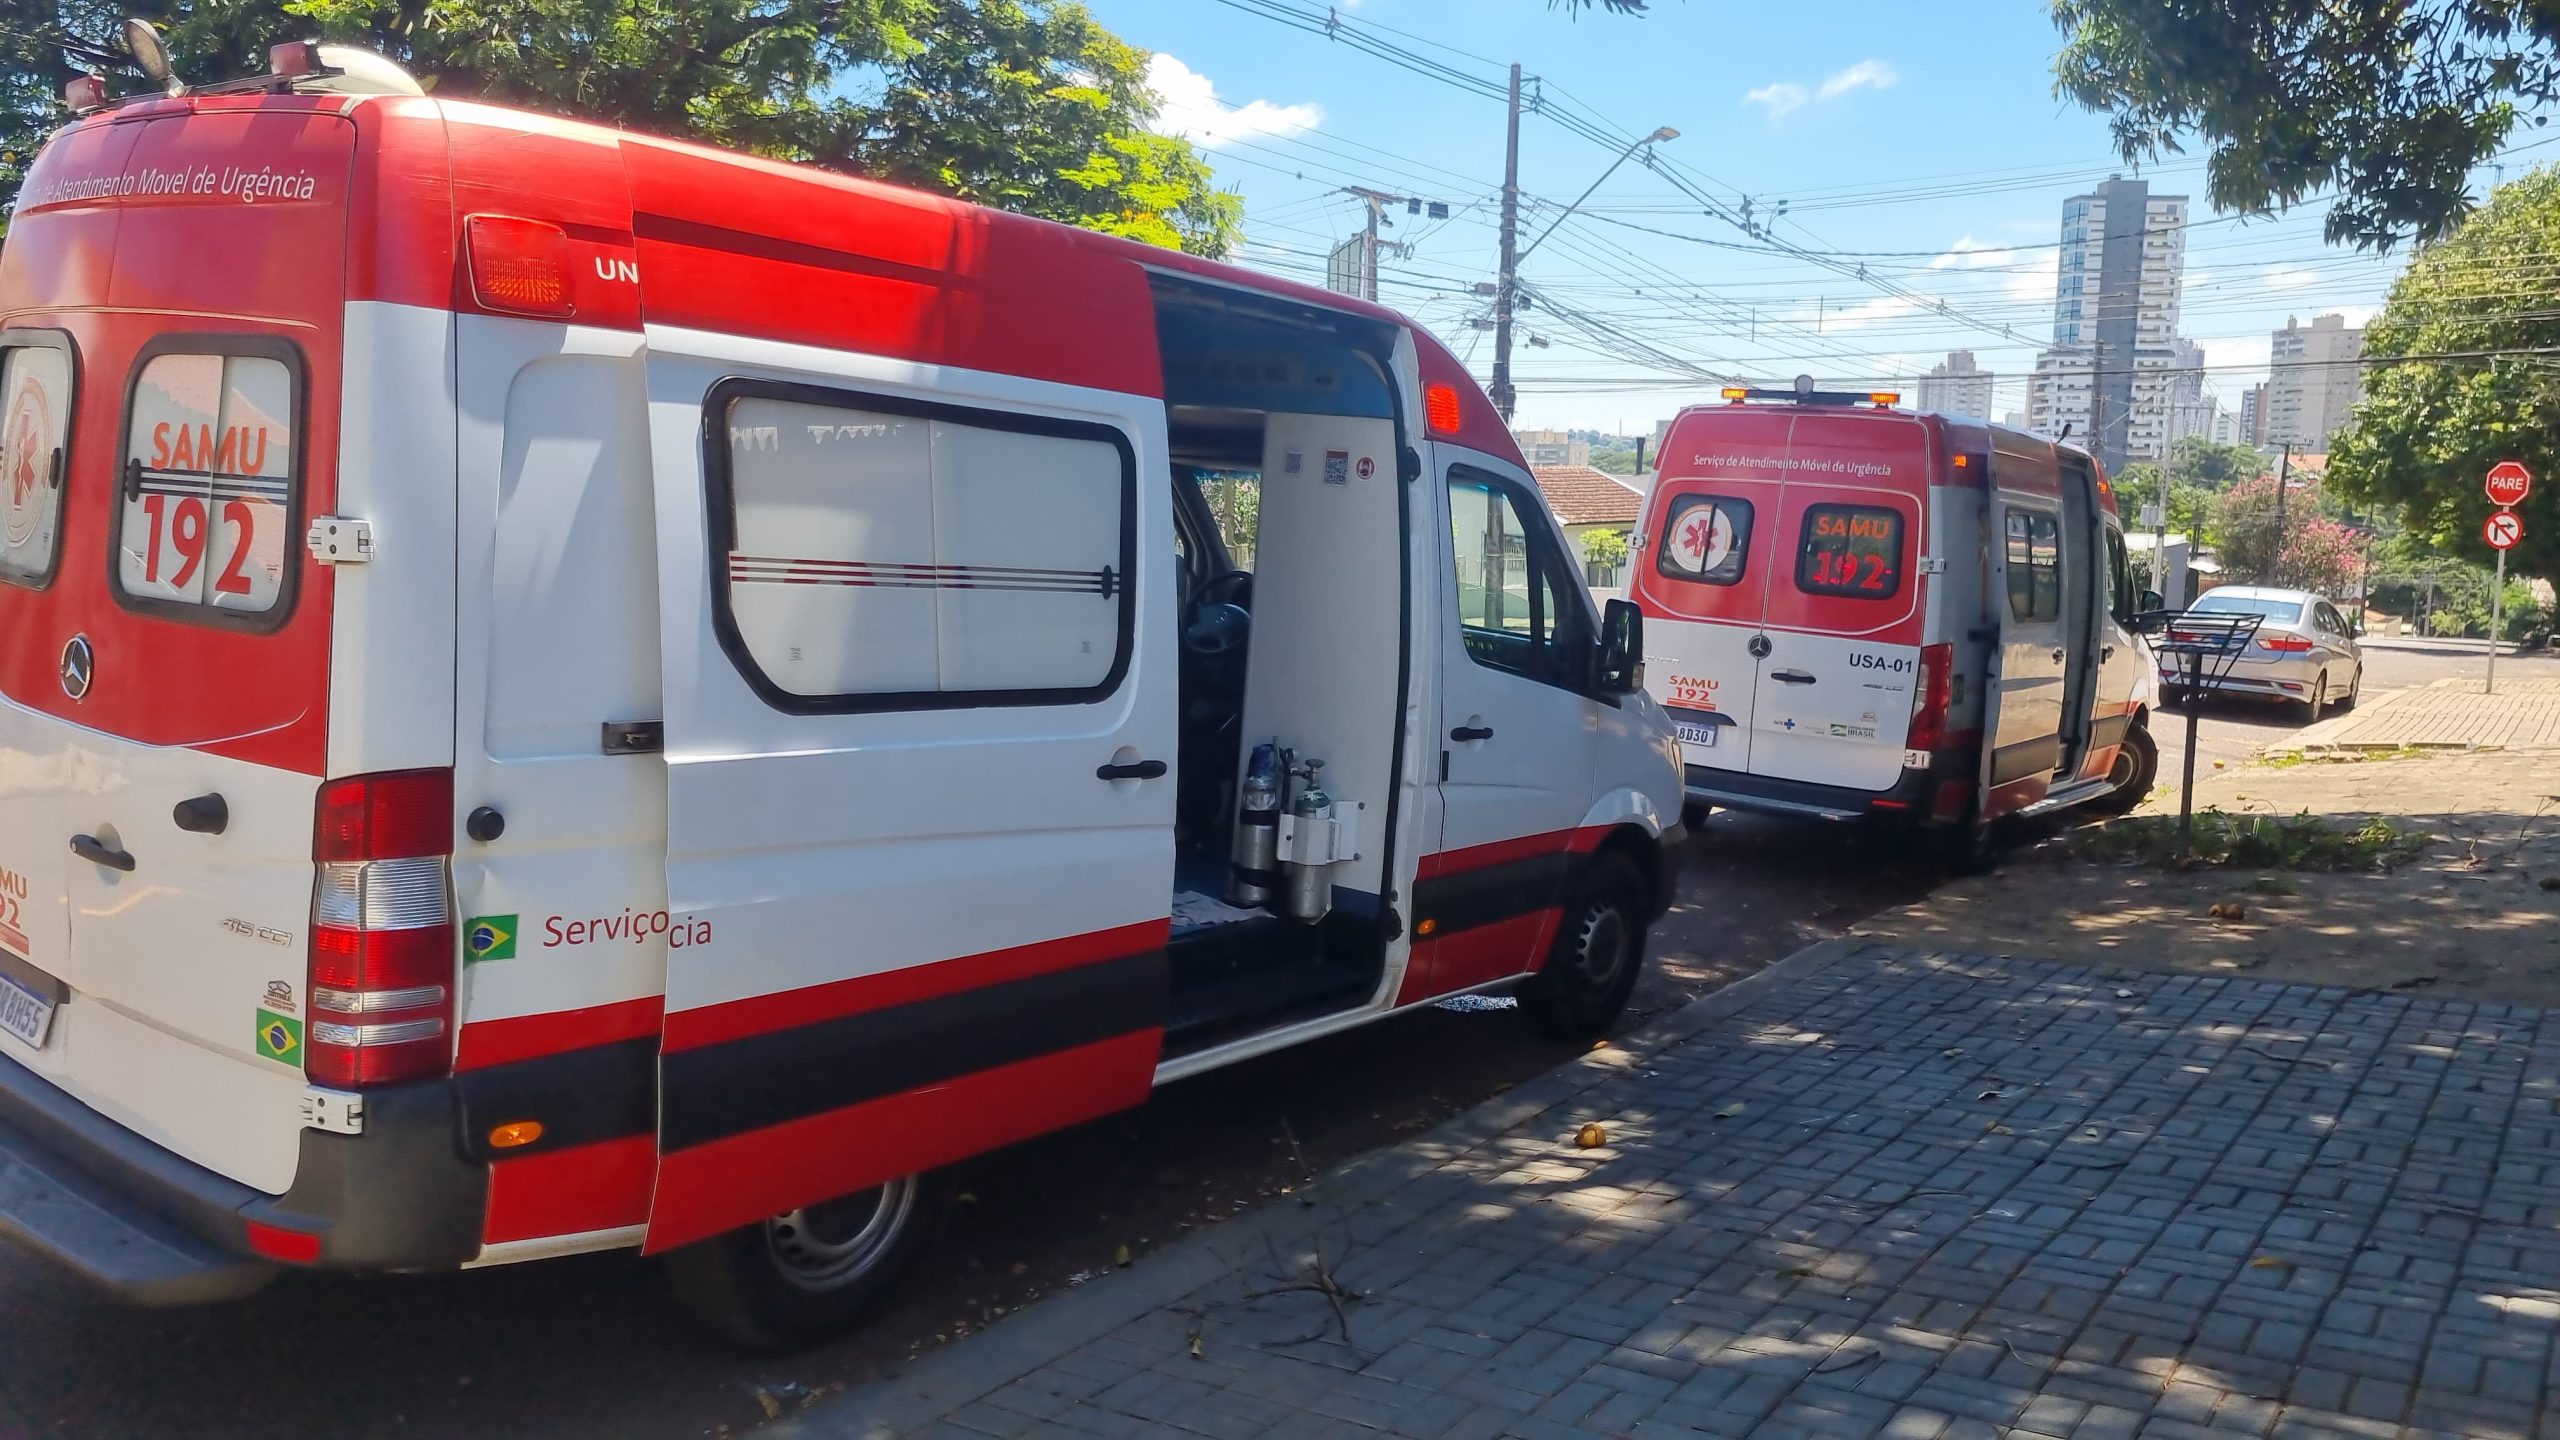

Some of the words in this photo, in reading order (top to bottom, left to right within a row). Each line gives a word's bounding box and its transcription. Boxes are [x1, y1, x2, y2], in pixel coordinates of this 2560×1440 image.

[54, 171, 135, 200] Atendimento
[137, 165, 192, 195] Movel
[193, 165, 216, 194] de
[221, 165, 315, 203] Urgência
[151, 421, 267, 476] SAMU
[1693, 455, 1725, 469] Serviço
[1726, 455, 1738, 467] de
[1739, 456, 1799, 470] Atendimento
[1800, 459, 1831, 472] Móvel
[1832, 461, 1845, 473] de
[1847, 462, 1891, 478] Urgência
[2490, 476, 2524, 491] PARE
[1816, 515, 1890, 539] SAMU
[143, 495, 254, 594] 192
[1817, 551, 1884, 590] 192
[1849, 652, 1912, 674] USA-01
[1669, 675, 1719, 690] SAMU
[1675, 686, 1710, 702] 192
[1678, 726, 1709, 743] 8D30
[543, 907, 669, 948] Serviço
